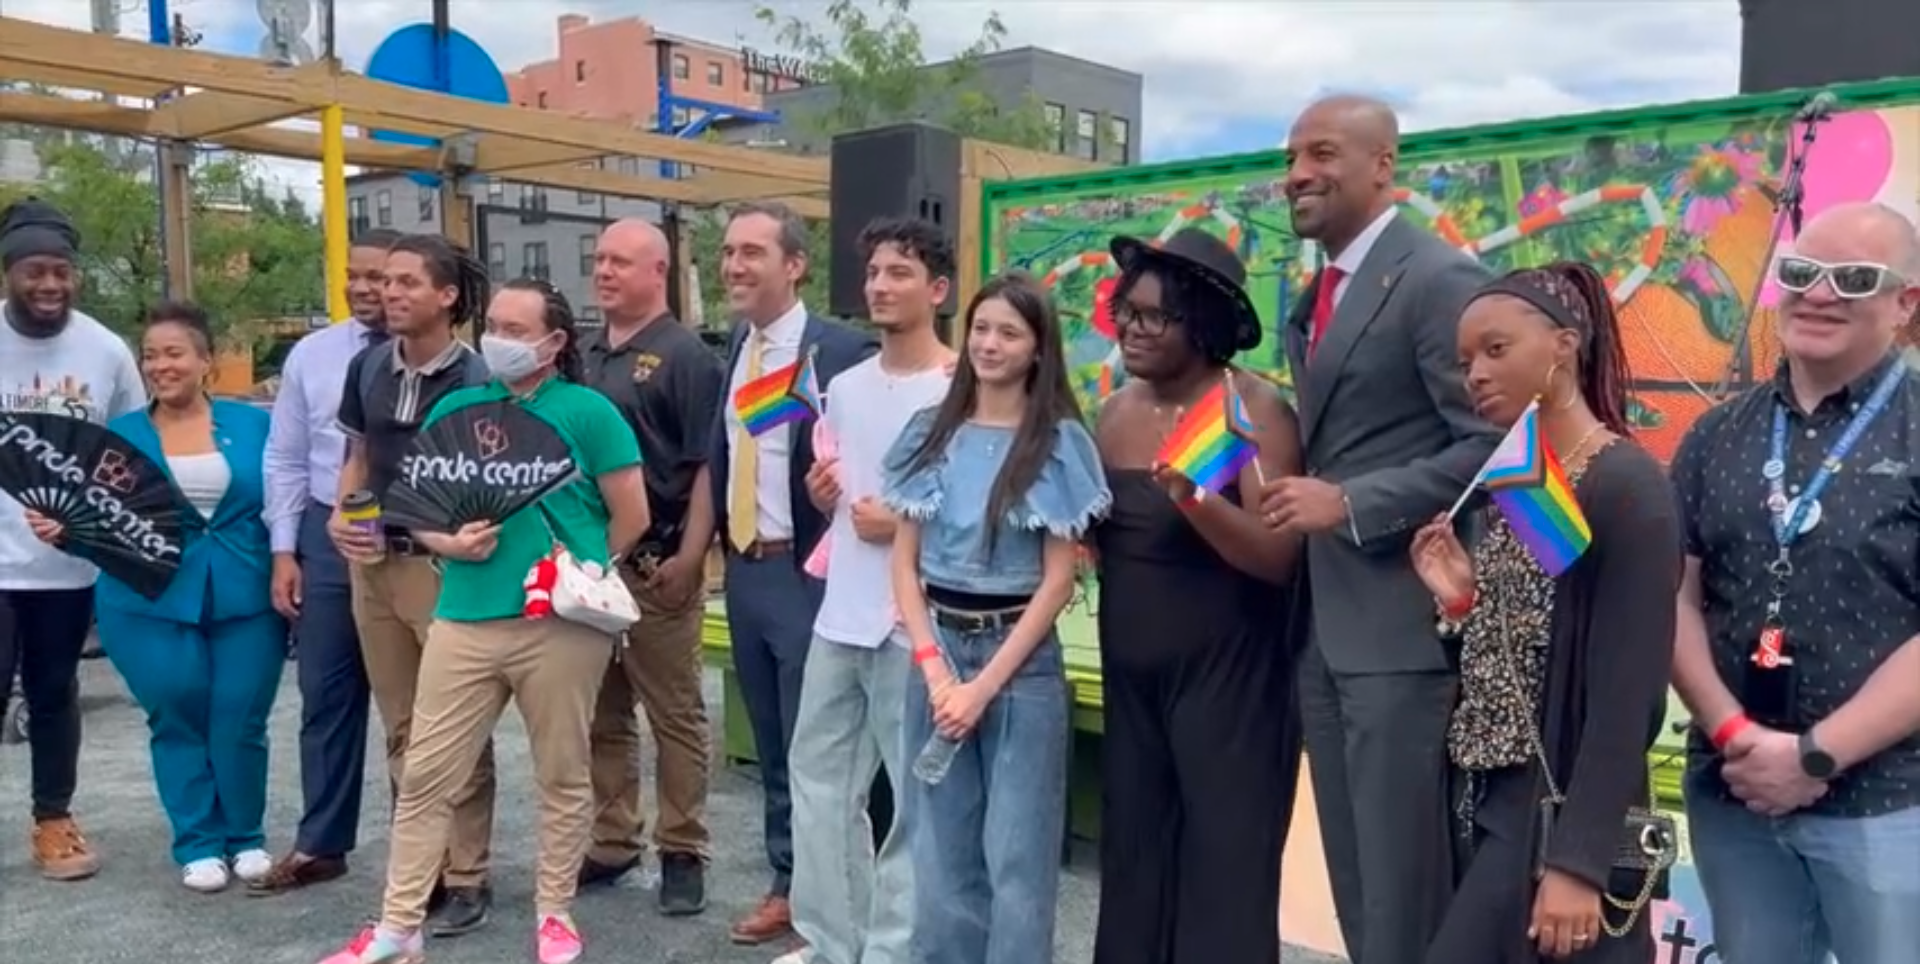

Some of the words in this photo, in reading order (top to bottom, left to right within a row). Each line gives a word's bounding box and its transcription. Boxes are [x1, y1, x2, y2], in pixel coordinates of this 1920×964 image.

[0, 424, 86, 485] pride
[85, 485, 181, 557] center
[410, 451, 479, 490] pride
[483, 455, 572, 486] center
